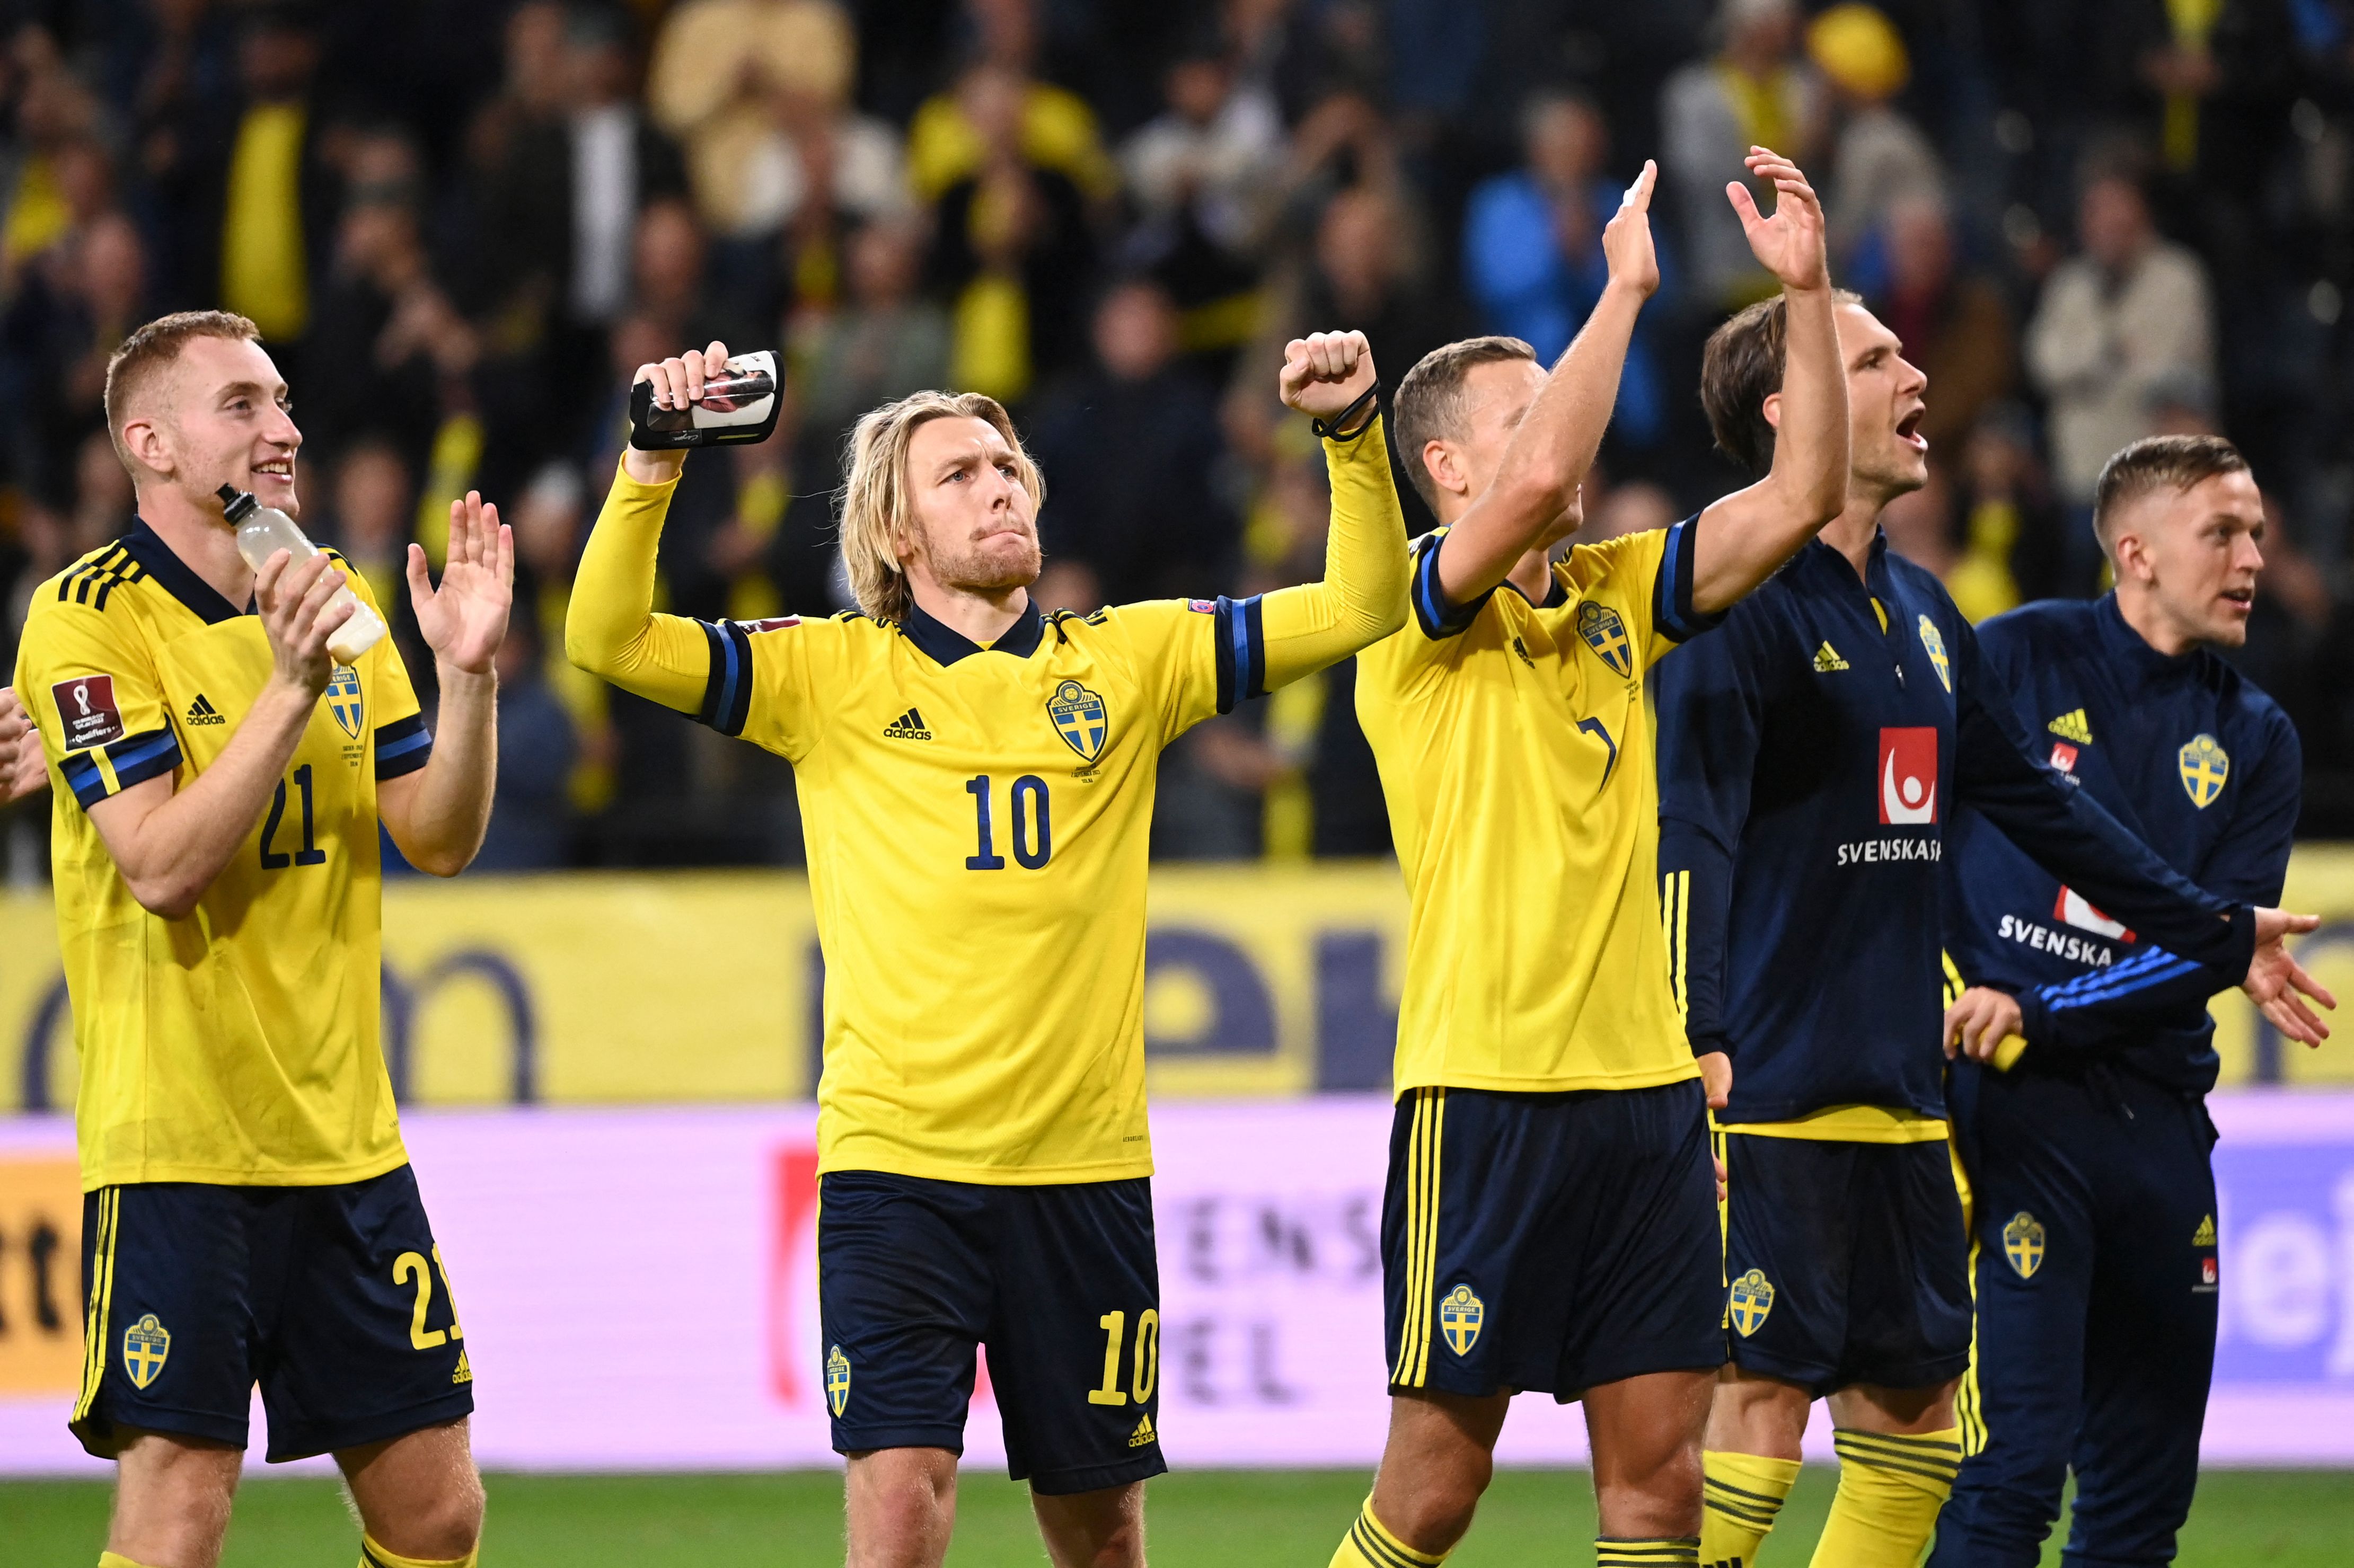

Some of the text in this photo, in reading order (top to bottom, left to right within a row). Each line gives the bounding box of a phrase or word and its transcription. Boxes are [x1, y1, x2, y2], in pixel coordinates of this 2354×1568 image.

[1057, 703, 1095, 713] SVERIGE
[186, 714, 225, 726] adidas
[883, 727, 931, 741] adidas
[966, 774, 1051, 870] 10
[1997, 914, 2112, 967] SVENSKA
[1088, 1308, 1159, 1406] 10
[1128, 1431, 1155, 1448] adidas
